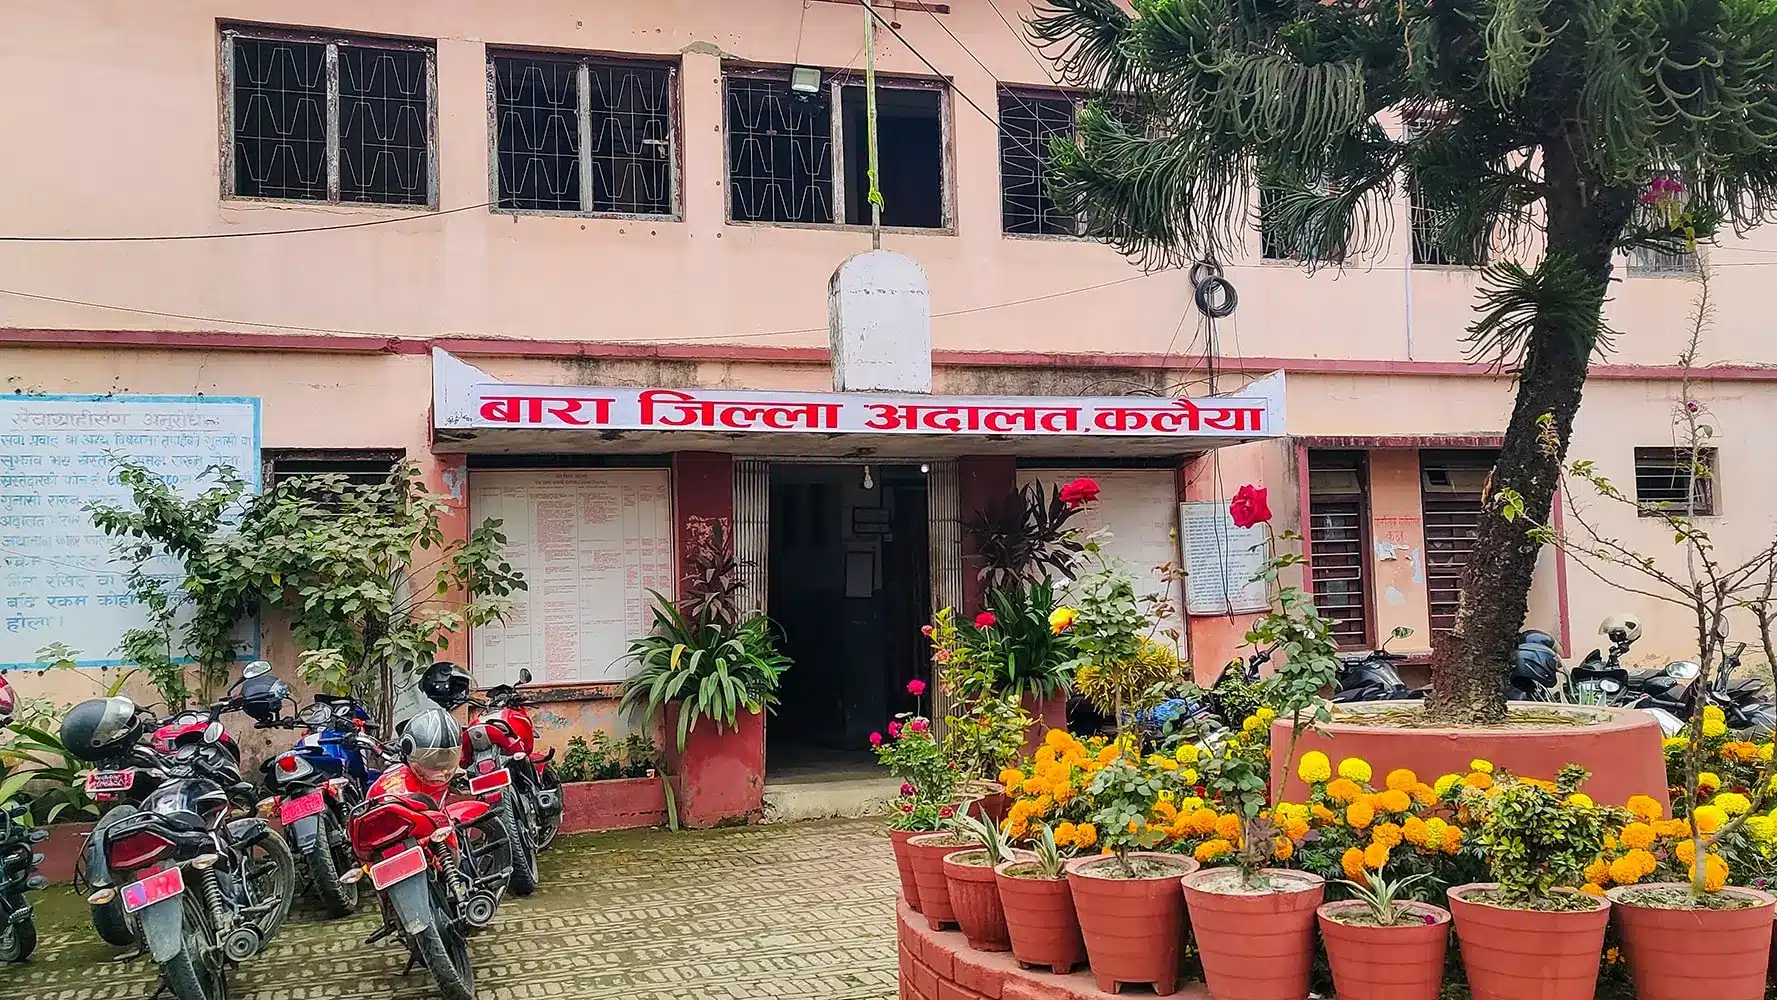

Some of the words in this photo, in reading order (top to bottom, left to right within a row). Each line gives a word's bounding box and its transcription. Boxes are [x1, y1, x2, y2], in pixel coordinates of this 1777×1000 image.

[479, 396, 616, 425] बारा
[637, 389, 844, 429] जिल्ला
[47, 595, 89, 609] रकम
